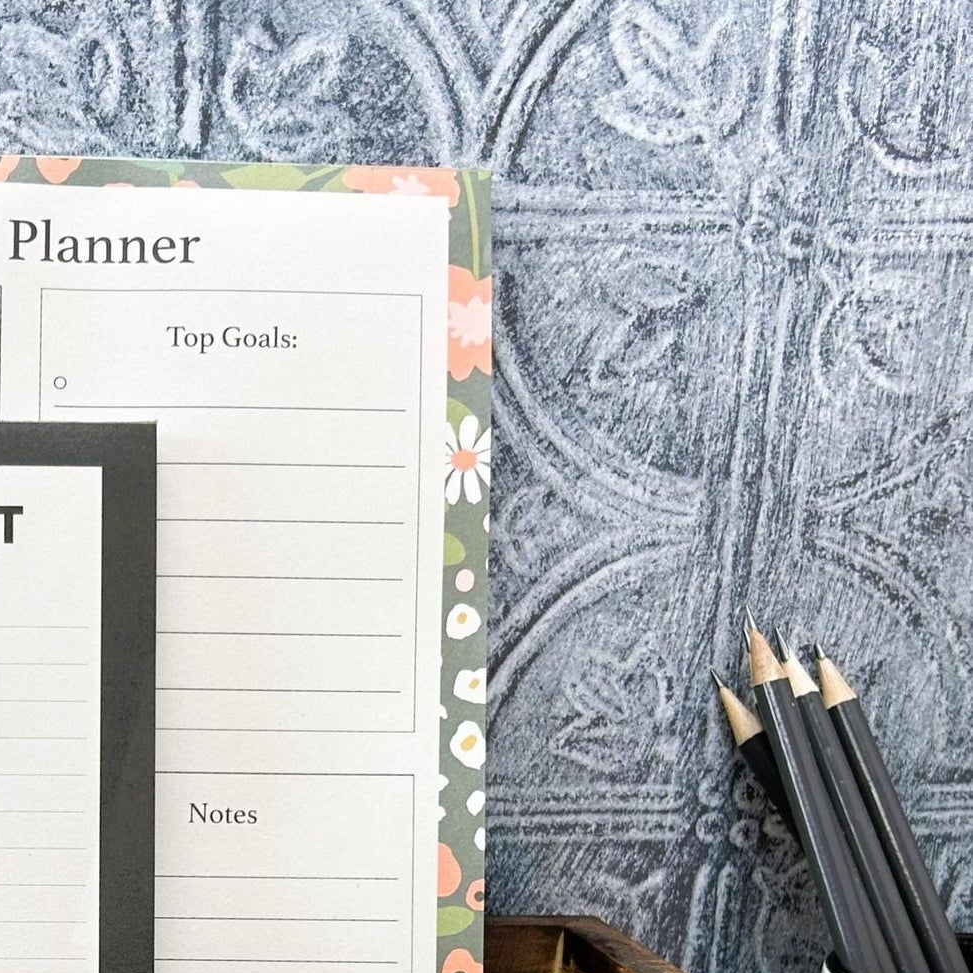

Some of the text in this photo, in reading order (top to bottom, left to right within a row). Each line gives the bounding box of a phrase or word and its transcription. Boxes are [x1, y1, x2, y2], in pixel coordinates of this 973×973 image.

[9, 219, 201, 264] Planner
[166, 325, 297, 354] Top Goals:
[188, 802, 258, 825] Notes
